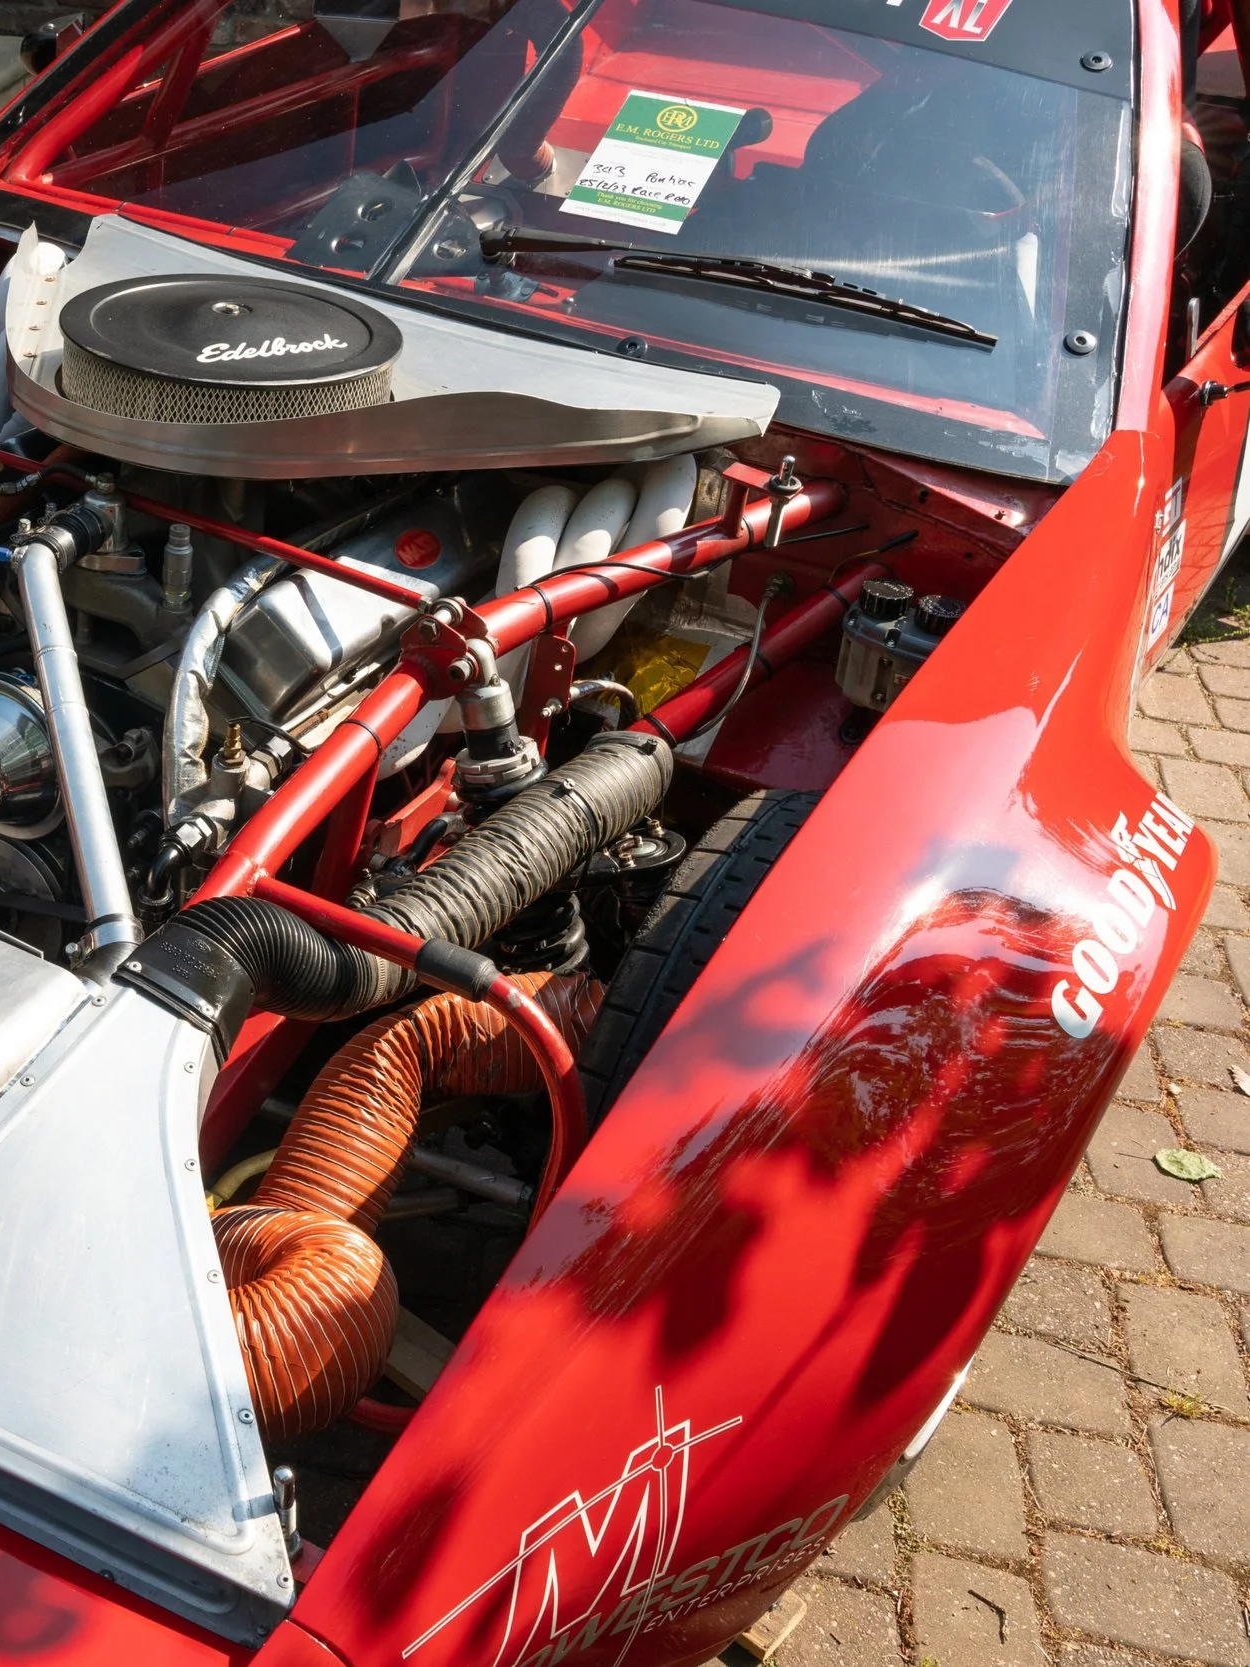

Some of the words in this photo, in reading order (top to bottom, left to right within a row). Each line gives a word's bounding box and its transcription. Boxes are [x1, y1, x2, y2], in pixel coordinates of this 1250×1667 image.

[615, 123, 639, 135] E.M.
[643, 128, 693, 144] ROGERS
[695, 138, 720, 149] LTD
[196, 333, 348, 363] Edelbrock
[643, 1536, 826, 1634] ENTERPRISES
